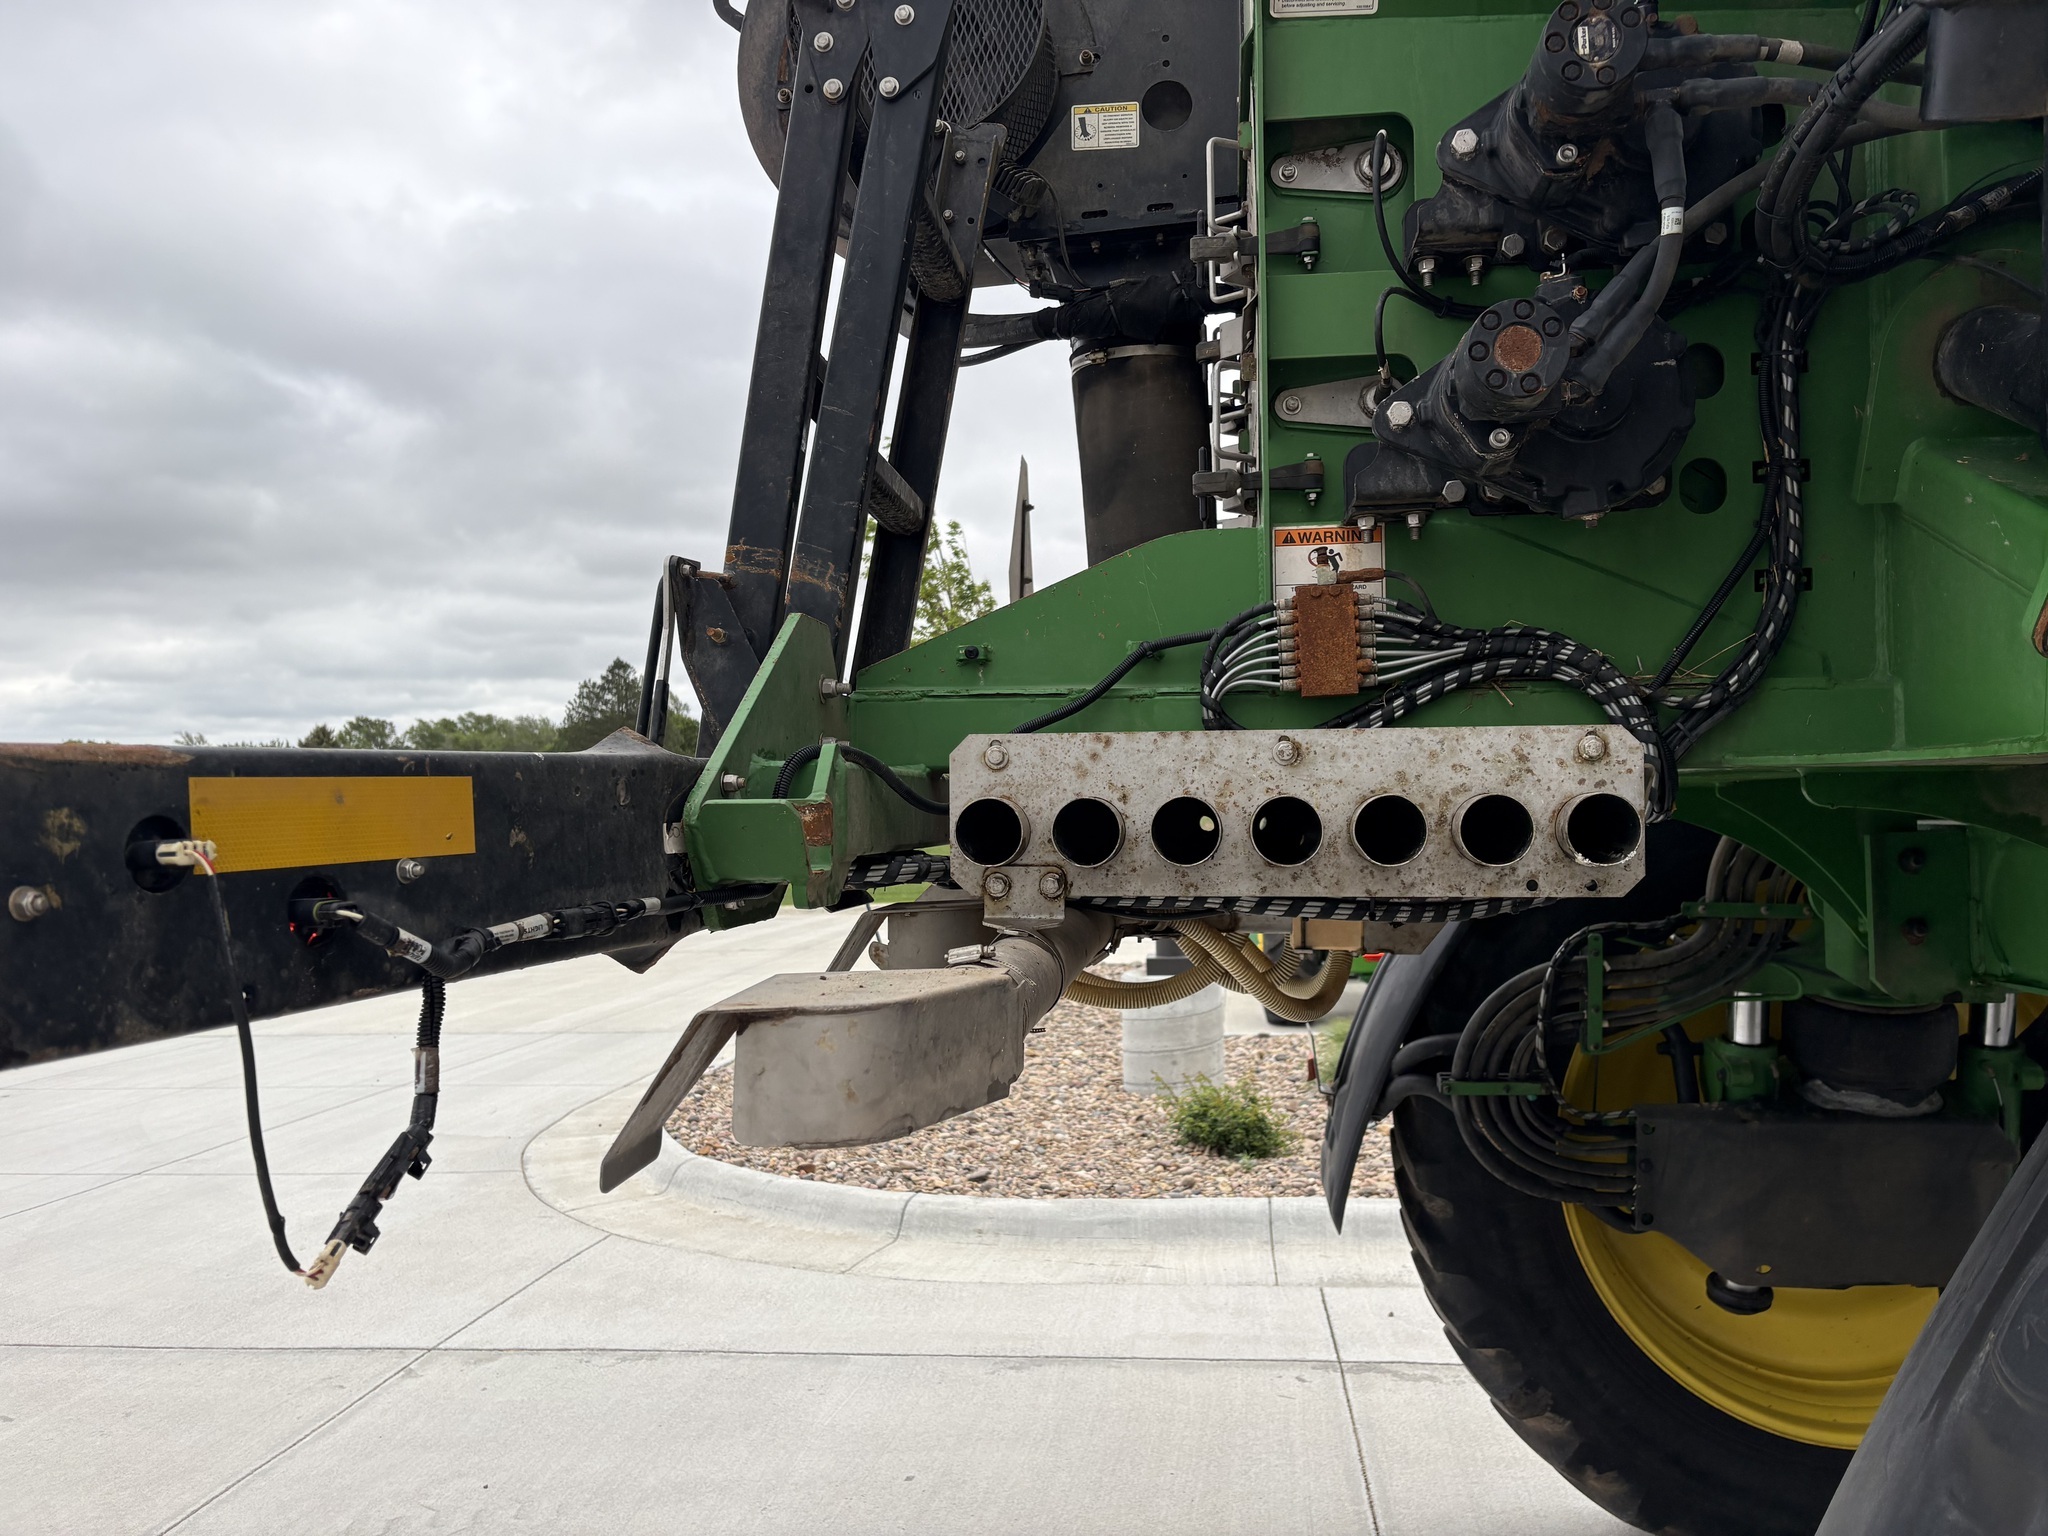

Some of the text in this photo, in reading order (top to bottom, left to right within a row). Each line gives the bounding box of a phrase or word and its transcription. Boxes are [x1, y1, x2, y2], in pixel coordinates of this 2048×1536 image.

[1094, 105, 1128, 113] CAUTION
[1297, 529, 1362, 543] WARNIN
[523, 924, 544, 934] LIGHTS
